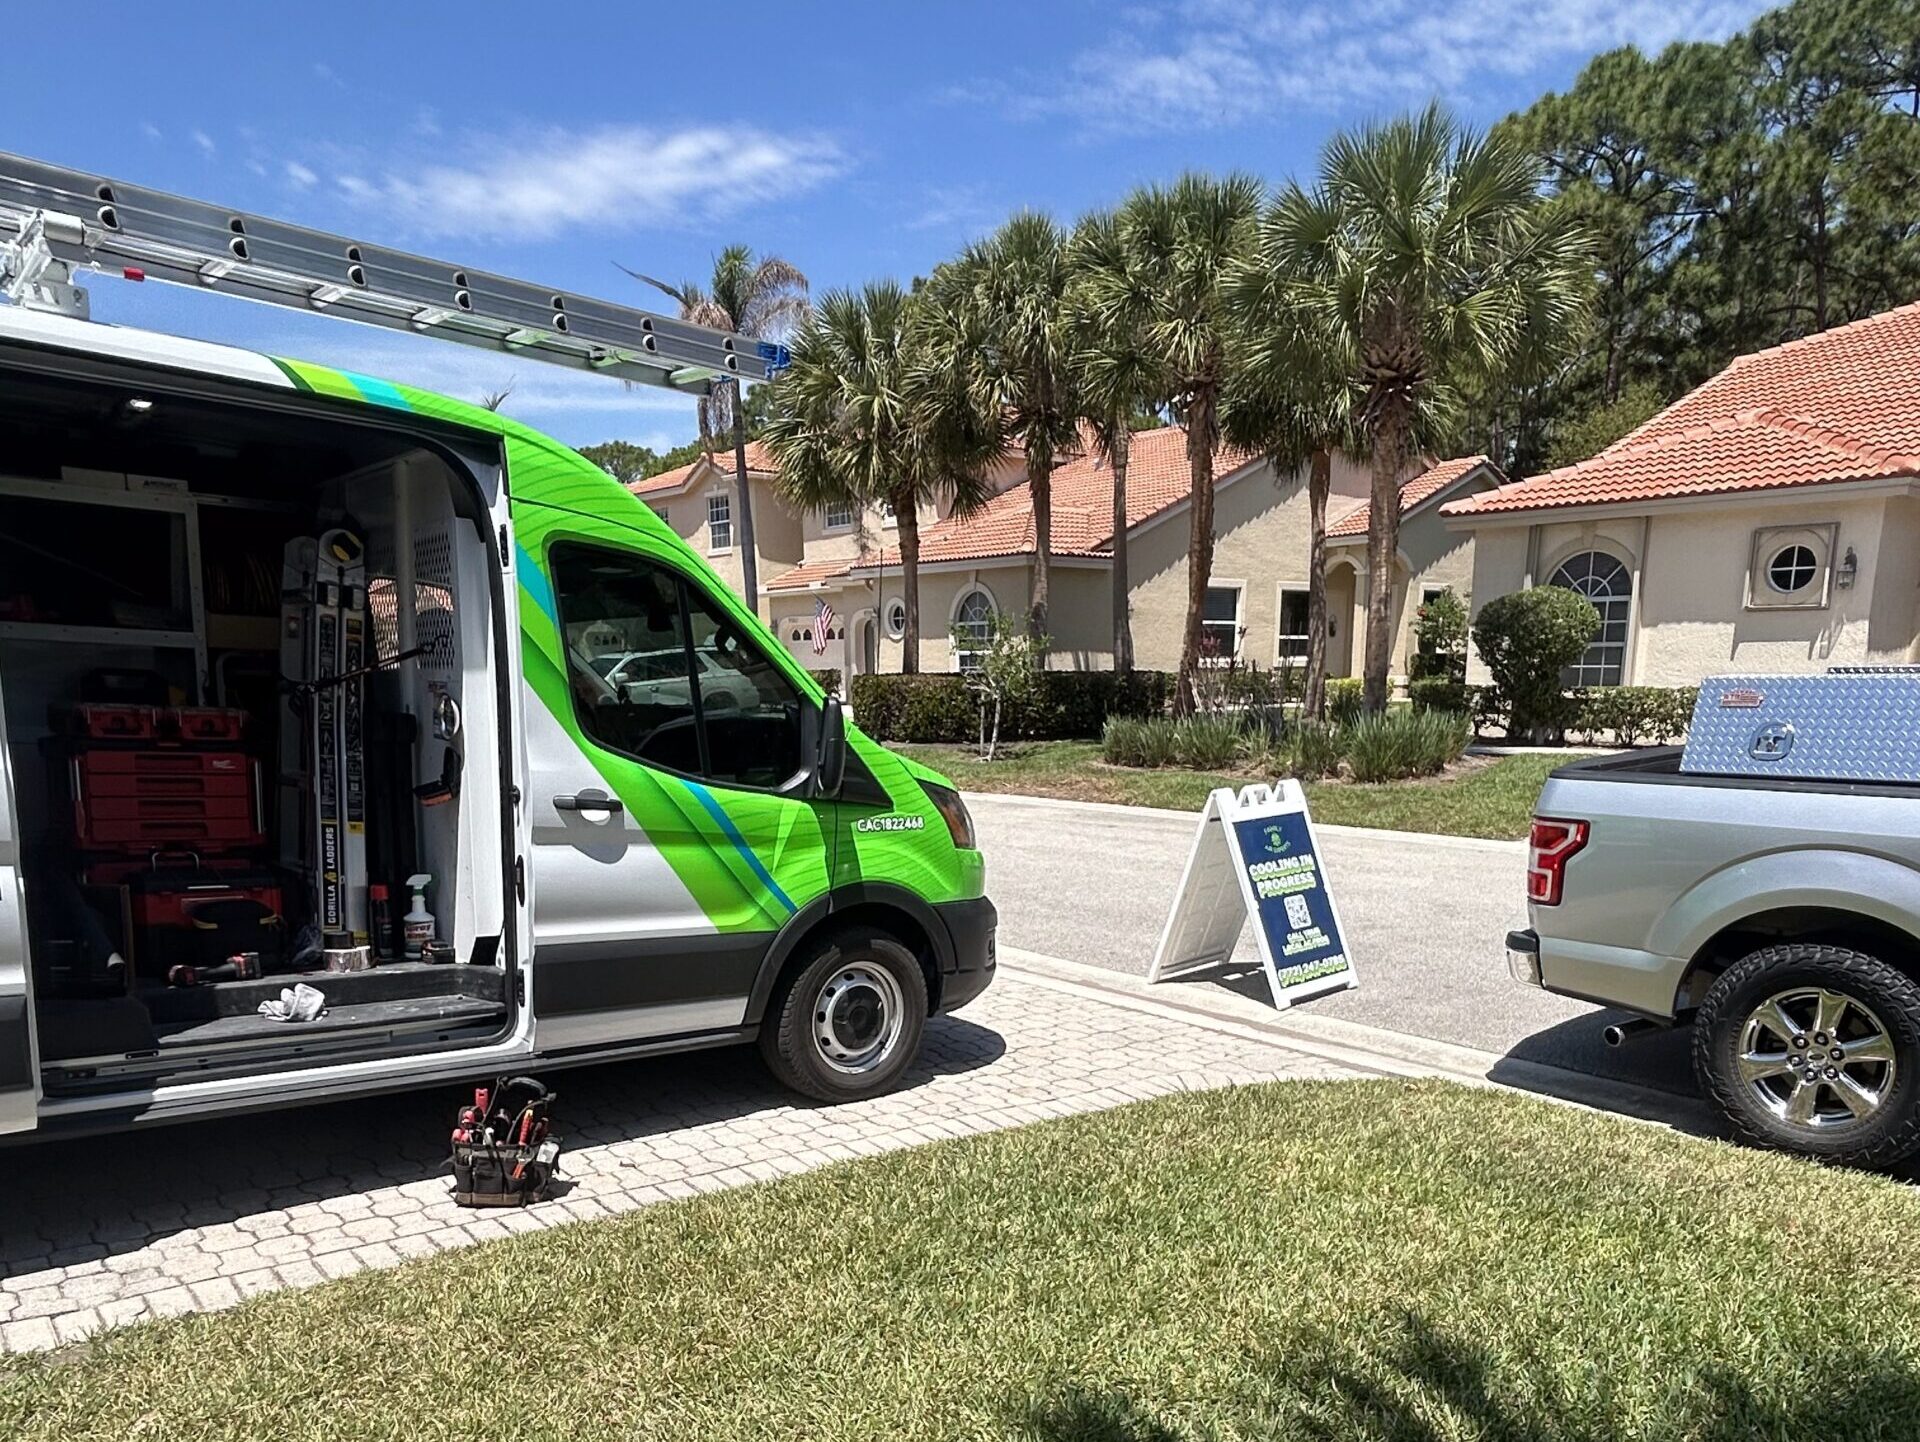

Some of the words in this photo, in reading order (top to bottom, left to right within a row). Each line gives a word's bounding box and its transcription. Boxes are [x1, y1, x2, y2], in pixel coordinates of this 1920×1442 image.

[857, 816, 924, 832] CAC1822468
[325, 827, 336, 869] LADDERS
[1249, 857, 1302, 880] COOLING
[1300, 854, 1316, 871] IN
[1257, 872, 1316, 897] PROGRESS
[327, 885, 337, 924] GORILLA
